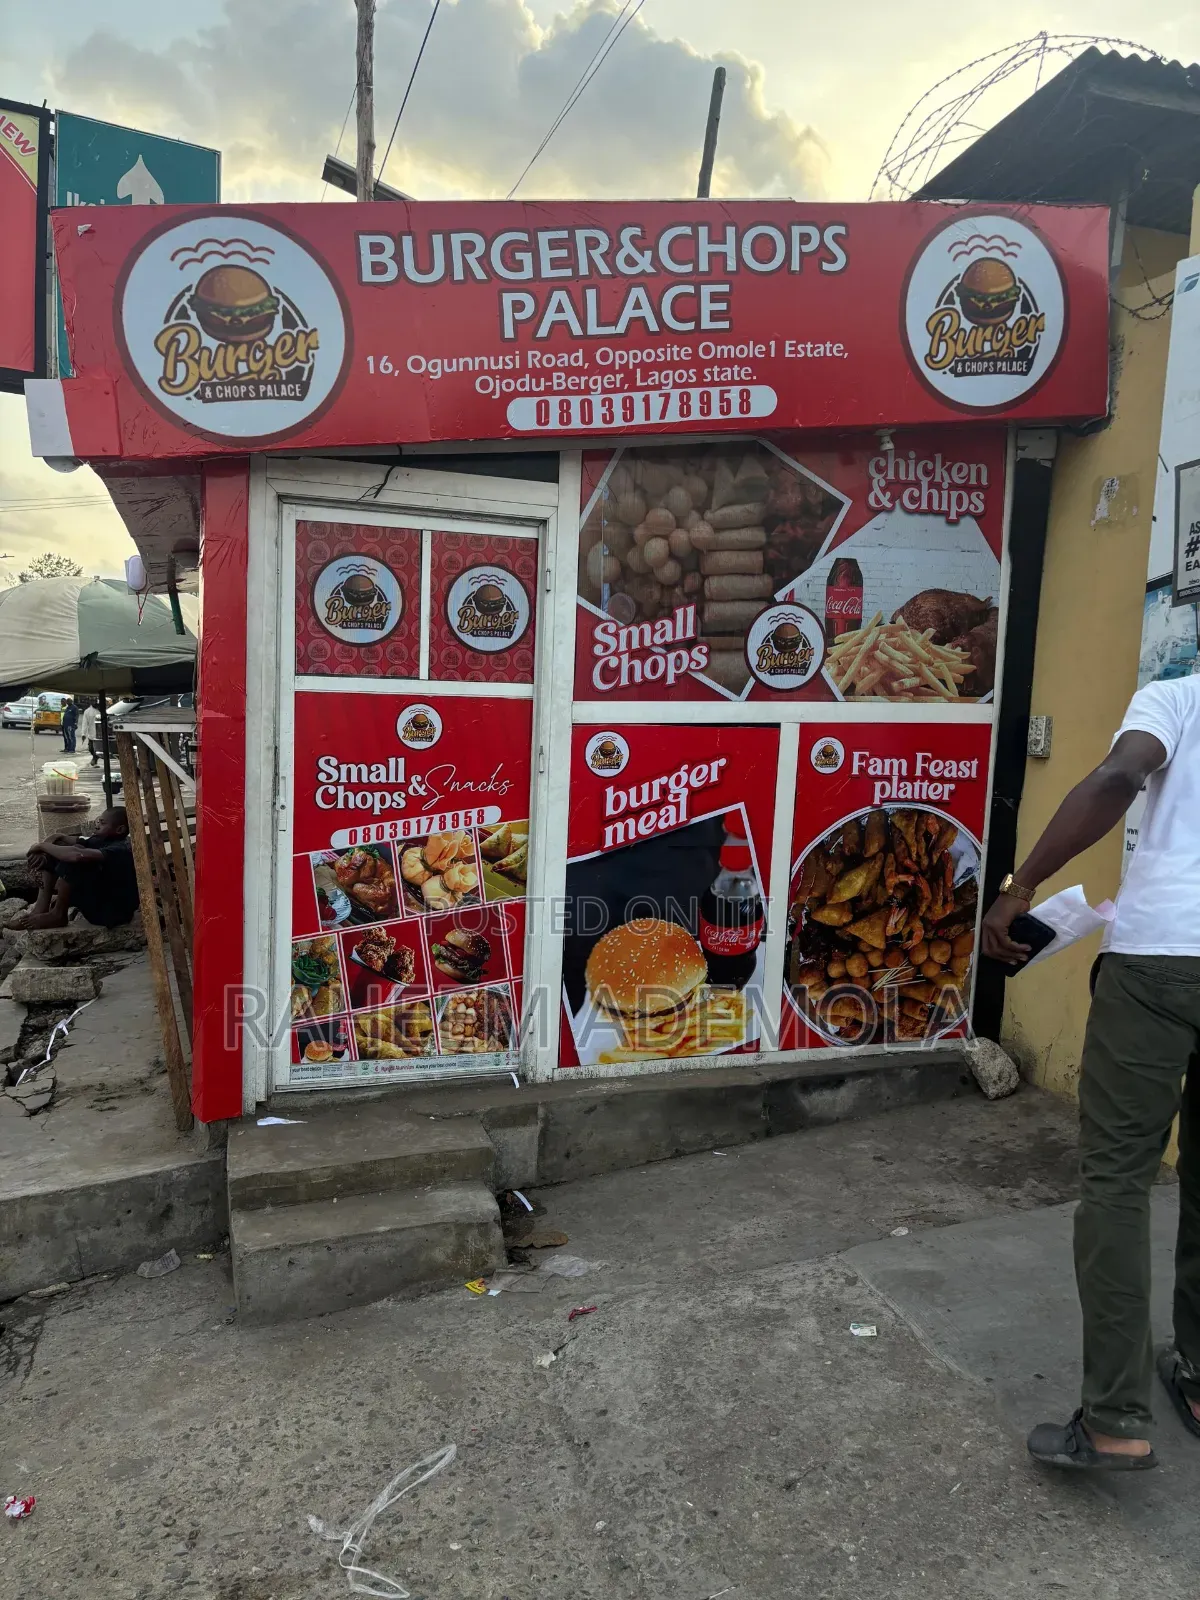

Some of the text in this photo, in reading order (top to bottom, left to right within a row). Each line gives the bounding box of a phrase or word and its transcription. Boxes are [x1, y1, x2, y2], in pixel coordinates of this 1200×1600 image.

[357, 224, 849, 284] BURGER&CHOPS
[500, 284, 731, 339] PALACE
[924, 306, 1046, 371] Burger
[153, 322, 320, 396] Burger
[366, 354, 400, 377] 16,
[406, 350, 521, 380] Ogunnusi
[527, 348, 590, 370] Road,
[595, 343, 693, 370] Opposite
[784, 340, 849, 359] Estate,
[956, 360, 1028, 373] & CHOPS PALACE
[204, 383, 302, 399] & CHOPS PALACE
[475, 364, 757, 399] Ojodu-Berger, Lagos state.
[535, 387, 752, 427] 08039178958
[868, 449, 989, 486] chicken
[868, 476, 986, 520] & chips
[325, 595, 392, 625] Burger
[457, 605, 519, 633] Burger
[593, 604, 697, 657] Small
[592, 645, 709, 692] Chops
[756, 644, 814, 672] Burger
[317, 755, 406, 784] Small
[851, 751, 979, 779] Fam Feast
[315, 784, 407, 816] Chops
[408, 762, 515, 811] & Snacks
[604, 757, 728, 817] burger
[873, 776, 956, 805] platter
[348, 809, 486, 846] 08039178958
[603, 788, 689, 849] meal
